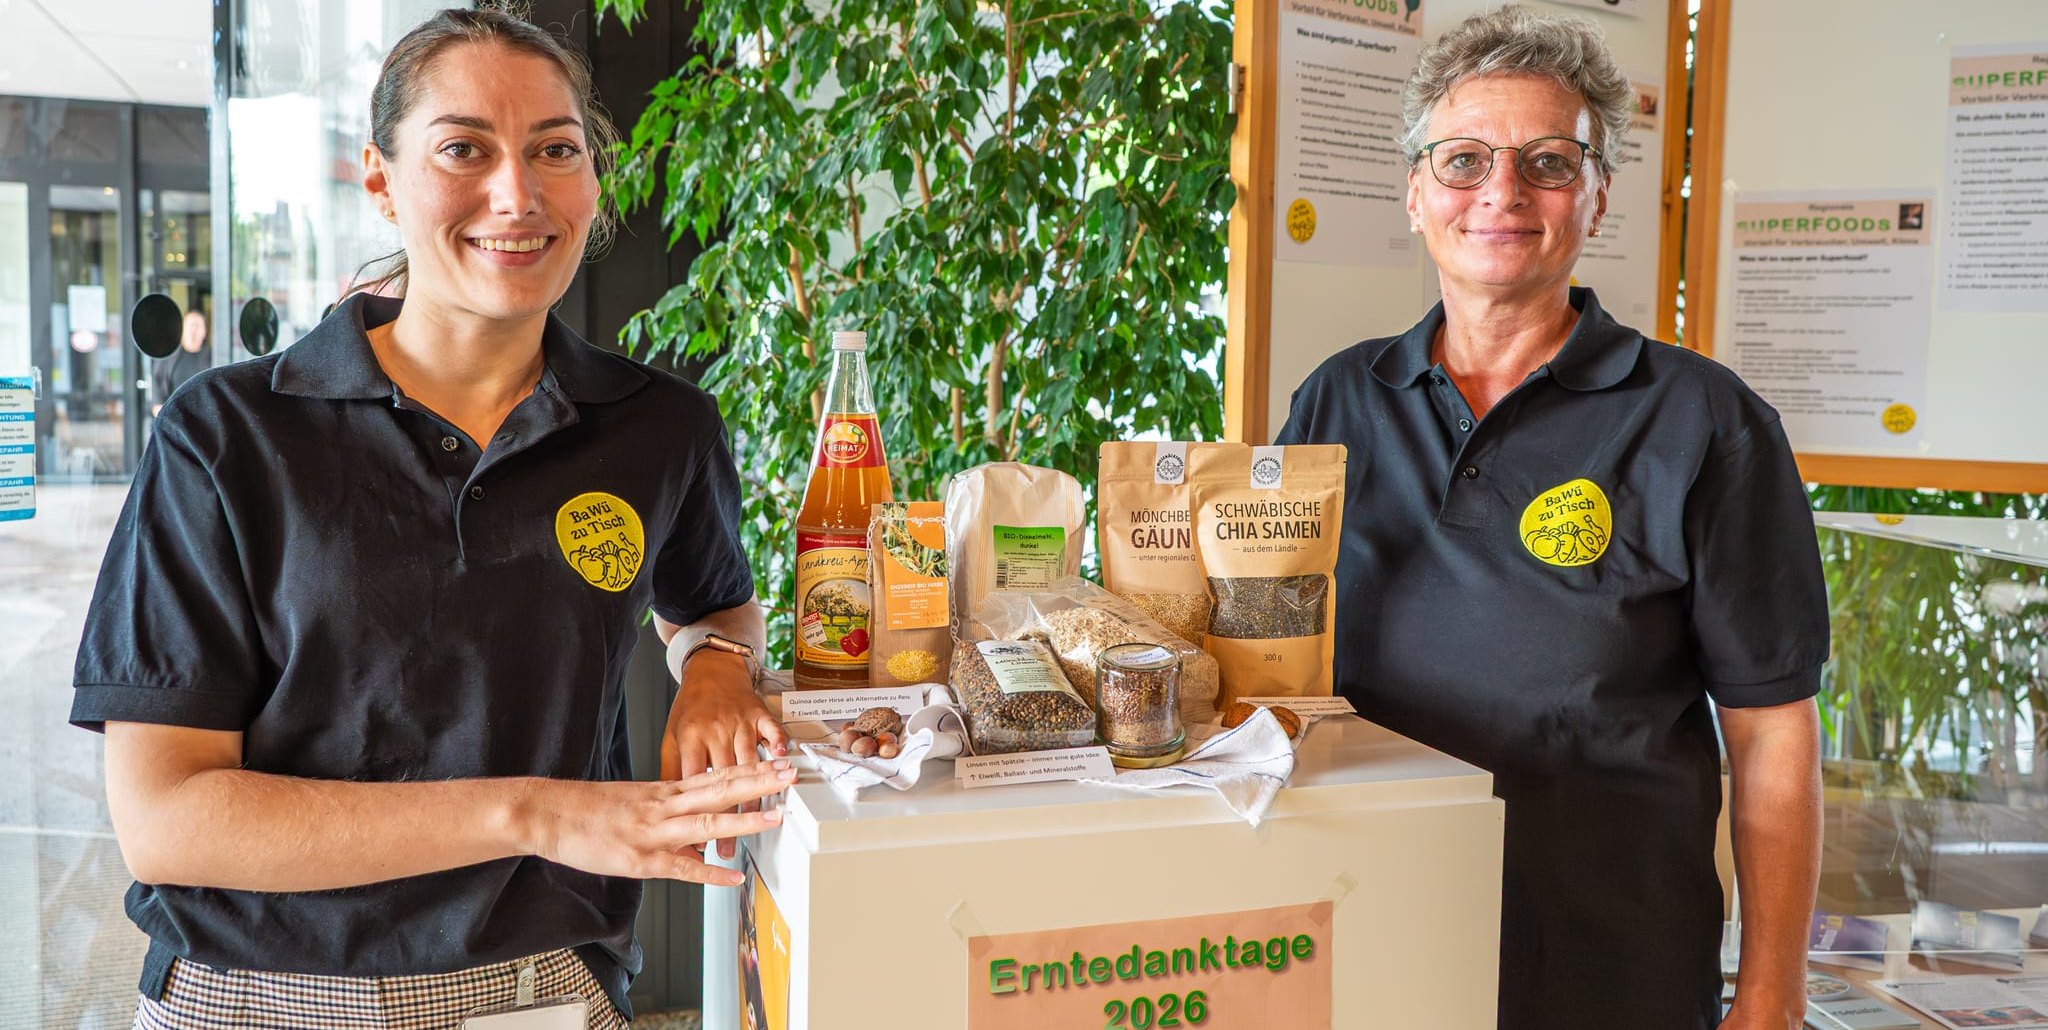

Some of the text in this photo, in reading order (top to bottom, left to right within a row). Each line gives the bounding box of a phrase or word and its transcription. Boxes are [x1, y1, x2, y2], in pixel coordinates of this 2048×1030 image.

[1544, 485, 1583, 507] BaWü
[569, 501, 613, 524] BaWü
[1131, 508, 1191, 524] MÖNCHBE
[1215, 500, 1321, 518] SCHWÄBISCHE
[1538, 498, 1595, 522] zu Tisch
[571, 514, 626, 540] zu Tisch
[1216, 520, 1321, 540] CHIA SAMEN
[1131, 525, 1191, 549] GÄUN
[1256, 544, 1273, 552] dem
[1275, 543, 1298, 552] Ländle
[802, 554, 868, 571] Landkreis-Apf
[1157, 553, 1190, 563] regionales
[1264, 653, 1277, 661] 300
[966, 760, 988, 768] Linsen
[989, 759, 1000, 767] mit
[1001, 757, 1025, 766] Spätzle
[1070, 753, 1085, 761] gute
[978, 772, 1003, 780] Eiweiß,
[1004, 770, 1028, 778] Ballast-
[1043, 765, 1087, 774] Mineralstoffe
[989, 933, 1314, 995] Erntedanktage
[1103, 990, 1208, 1030] 2026
